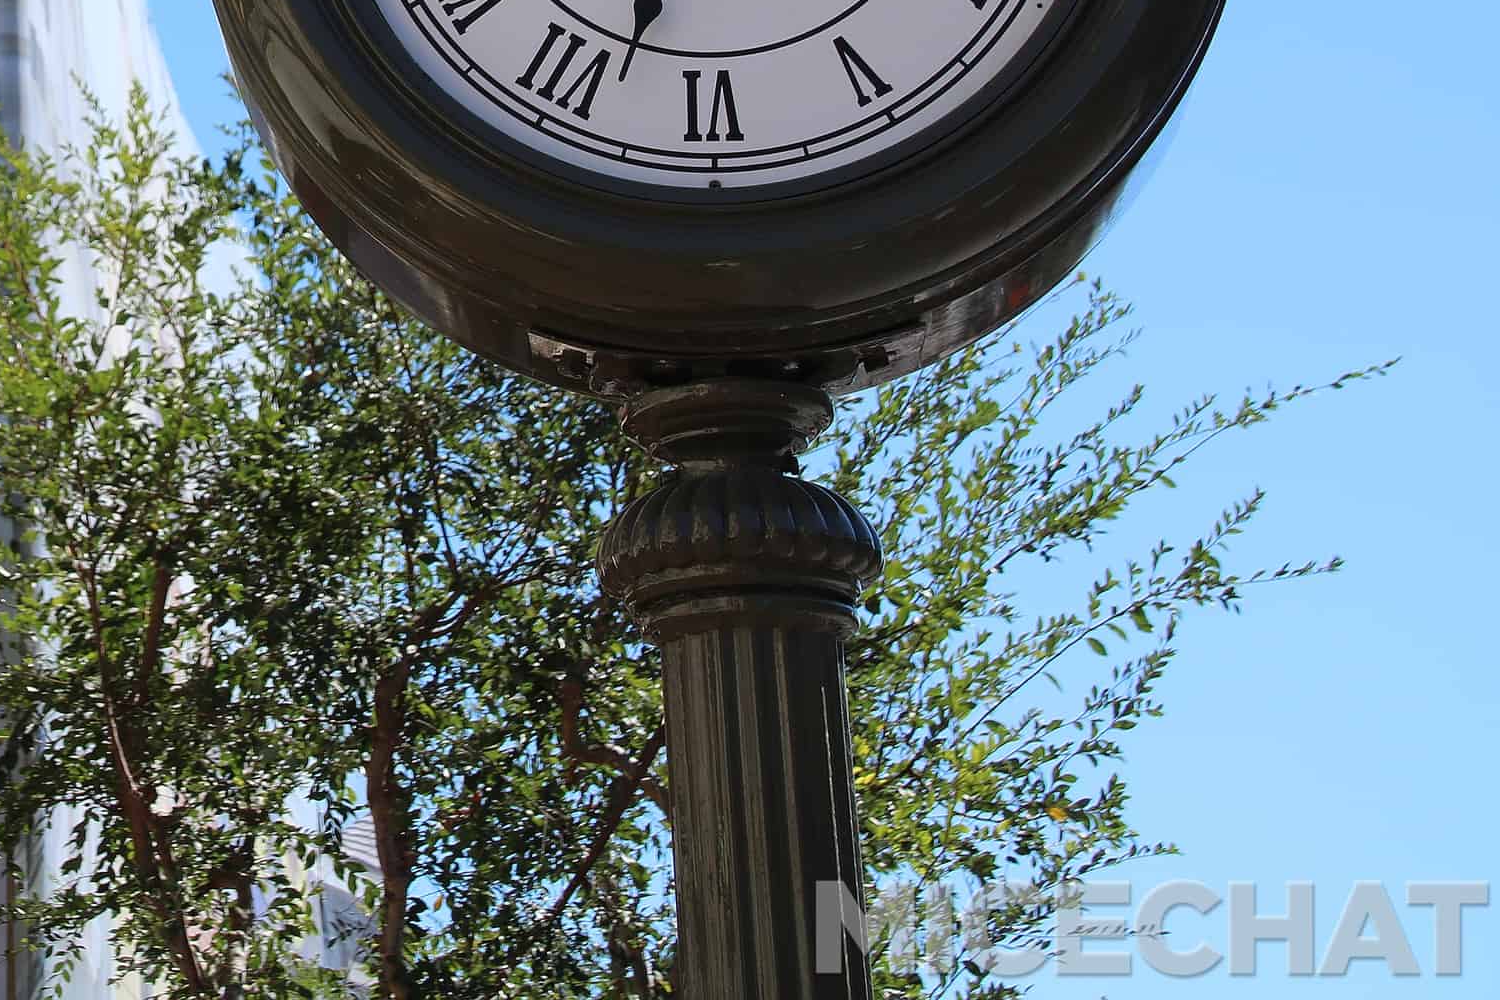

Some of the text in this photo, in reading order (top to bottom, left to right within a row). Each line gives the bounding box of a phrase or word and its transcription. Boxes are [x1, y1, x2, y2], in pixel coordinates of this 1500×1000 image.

[515, 22, 611, 120] VII
[683, 70, 744, 141] VI
[833, 36, 893, 107] V
